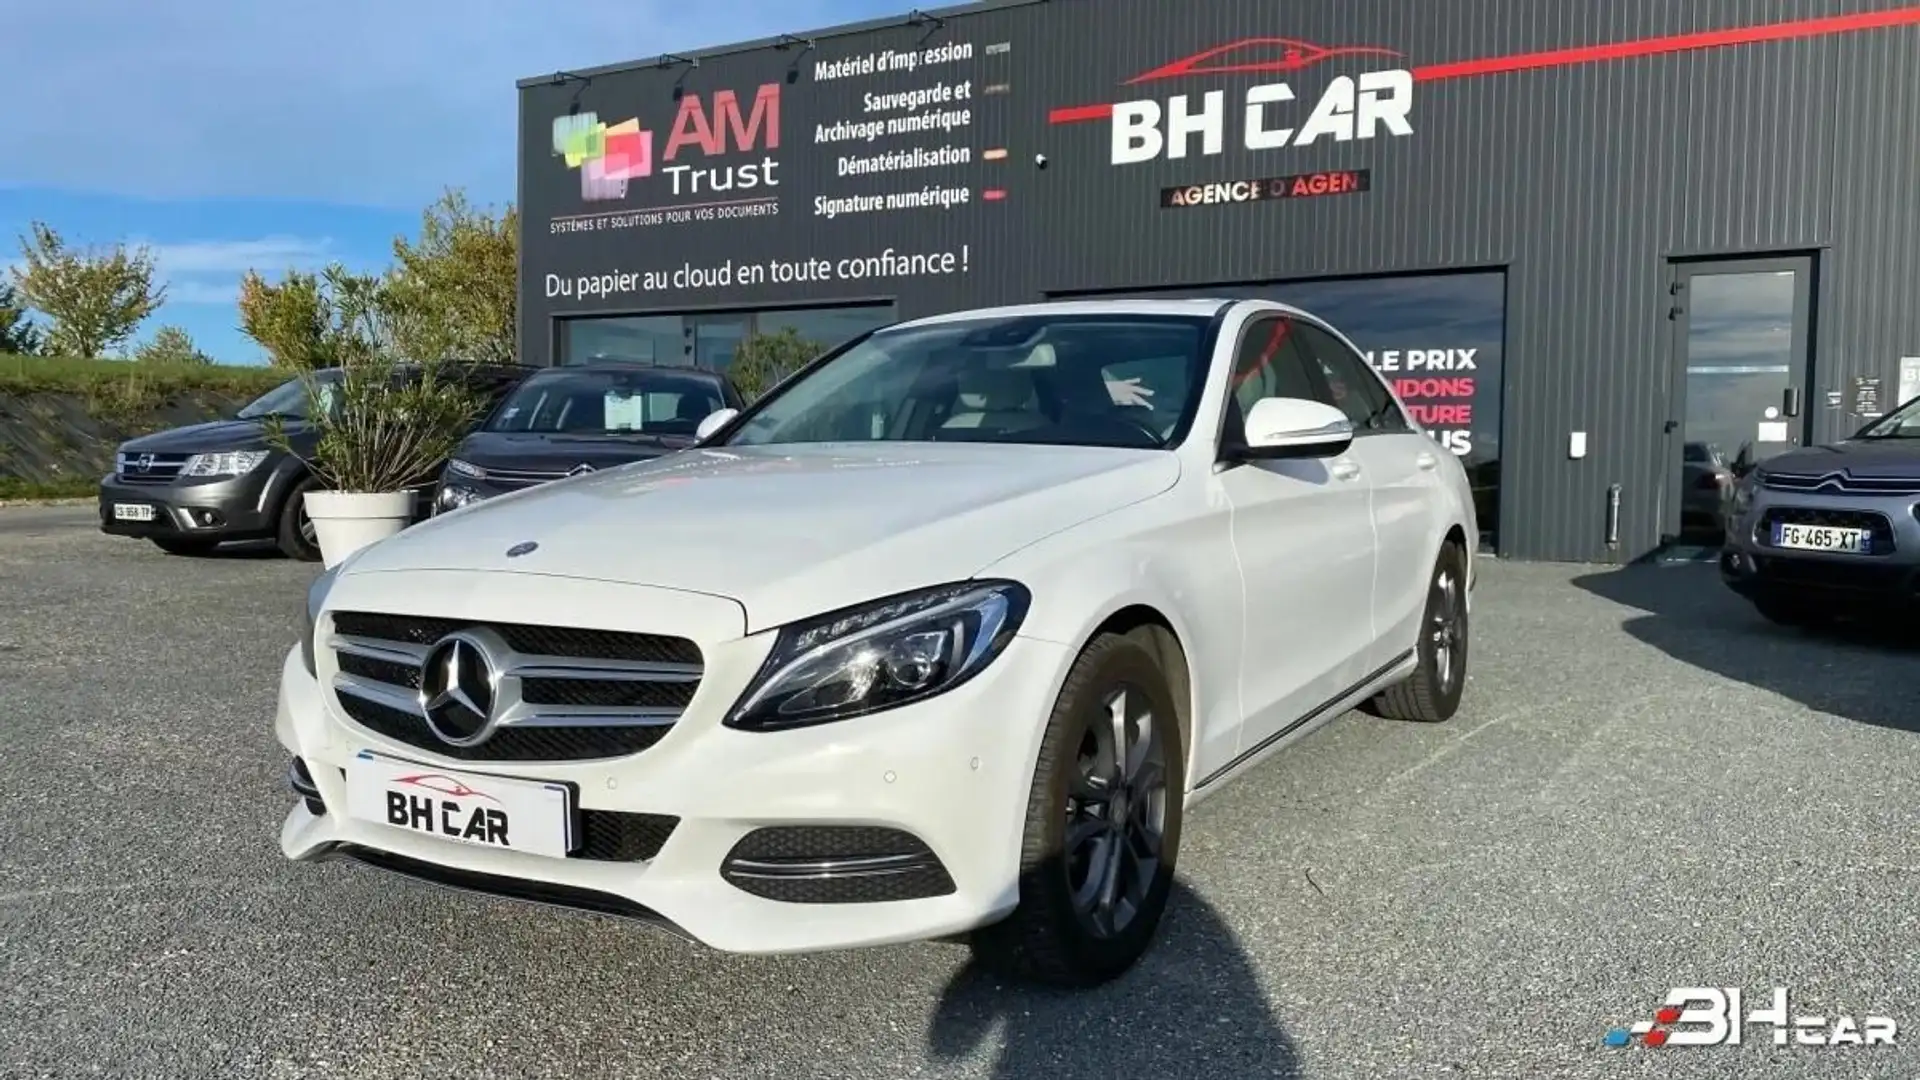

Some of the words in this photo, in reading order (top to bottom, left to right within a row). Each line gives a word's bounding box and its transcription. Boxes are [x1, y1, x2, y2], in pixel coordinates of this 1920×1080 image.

[814, 53, 874, 81] Matériel
[863, 82, 951, 112] Sauvegarde
[954, 80, 972, 99] et
[663, 83, 779, 161] AM
[814, 120, 885, 143] Archivage
[887, 108, 970, 133] numérique
[1111, 90, 1224, 165] BH
[1244, 69, 1414, 150] CAR
[662, 157, 779, 195] Trust
[838, 145, 970, 176] Dématérialisation
[814, 195, 883, 219] Signature
[886, 186, 969, 209] numérique
[1171, 180, 1261, 206] AGENCE
[597, 217, 608, 230] ET
[611, 213, 663, 228] SOLUTIONS
[666, 210, 691, 222] POUR
[695, 208, 714, 220] VOS
[718, 203, 779, 219] DOCUMENTS
[545, 274, 572, 297] Du
[577, 269, 638, 300] papier
[643, 271, 668, 290] au
[673, 260, 731, 288] cloud
[737, 264, 764, 285] en
[770, 258, 831, 283] toute
[837, 248, 955, 279] confiance
[1365, 351, 1399, 371] LE
[1407, 349, 1477, 370] PRIX
[1782, 527, 1859, 549] FG-465-XT
[387, 790, 433, 832] BH
[441, 801, 510, 846] CAR
